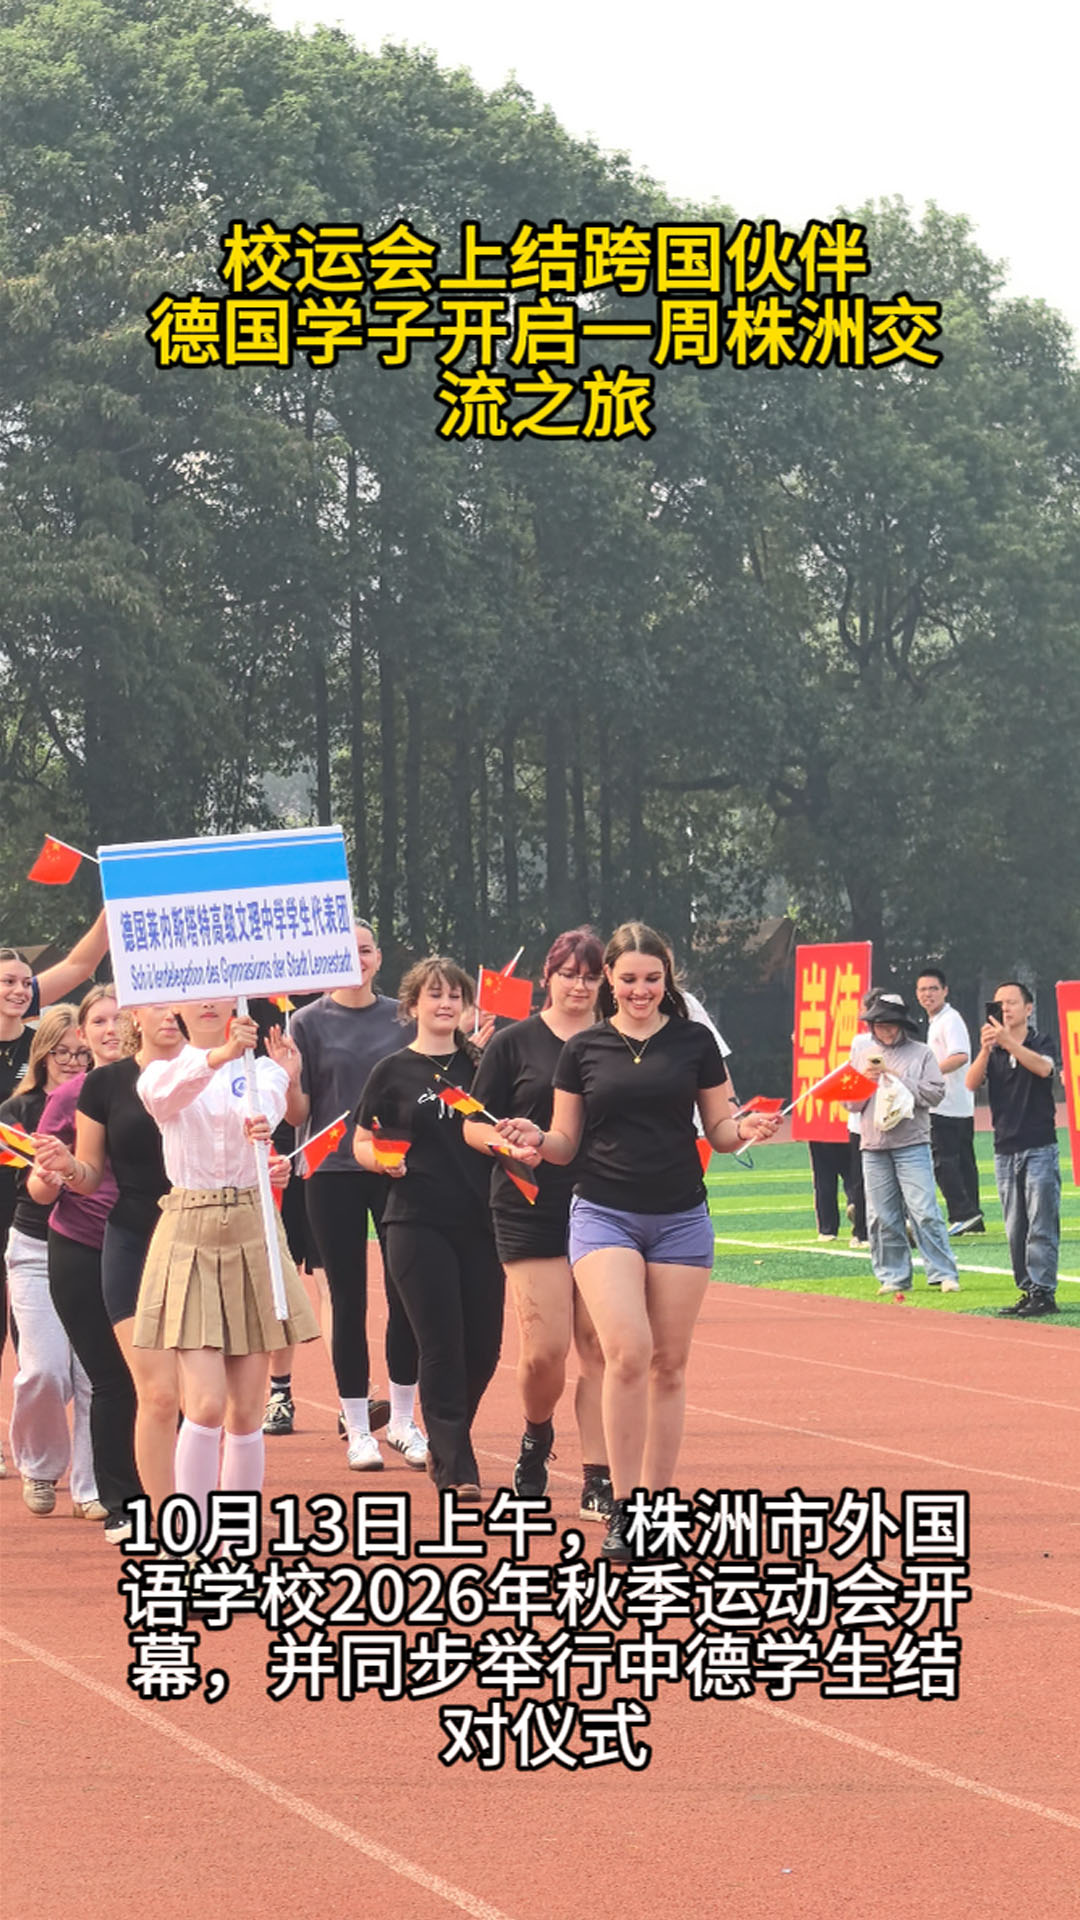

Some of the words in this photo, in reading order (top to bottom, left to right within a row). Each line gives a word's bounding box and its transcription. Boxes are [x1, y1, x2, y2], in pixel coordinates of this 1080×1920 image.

[120, 894, 351, 953] 德国莱内斯塔特高级文理中学学生代表团
[207, 957, 221, 984] des
[273, 953, 286, 978] der
